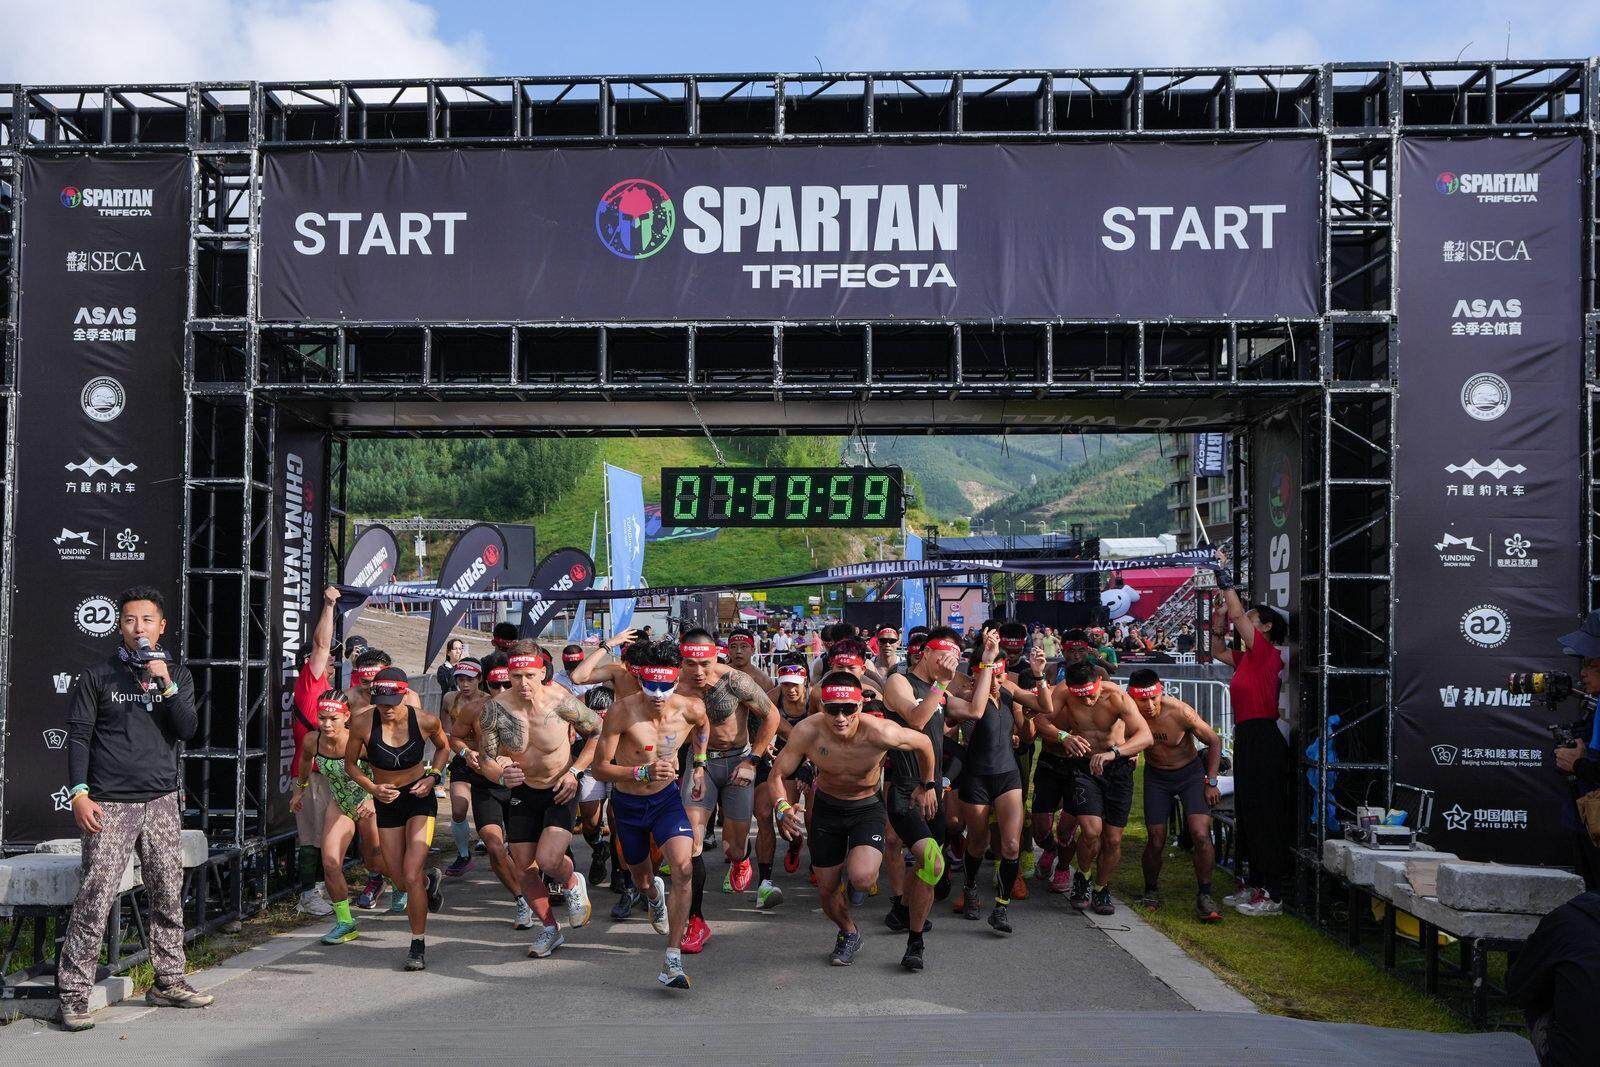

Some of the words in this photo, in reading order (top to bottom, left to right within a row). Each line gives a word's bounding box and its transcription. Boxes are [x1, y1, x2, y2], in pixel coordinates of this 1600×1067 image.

[1460, 173, 1539, 193] SPARTAN
[82, 188, 152, 207] SPARTAN
[98, 209, 152, 217] TRIFECTA
[682, 184, 958, 254] SPARTAN
[293, 211, 467, 257] START
[1102, 205, 1287, 250] START
[1469, 240, 1532, 261] SECA
[91, 251, 146, 272] SECA
[742, 263, 957, 289] TRIFECTA
[73, 328, 136, 341] 全季全体育
[1452, 322, 1522, 336] 全季全体育
[1206, 432, 1222, 471] RTAN
[284, 452, 304, 540] CHINA
[673, 475, 889, 520] 07:59:59
[1446, 484, 1525, 496] 方程豹汽车
[301, 511, 312, 611] SPARTAN
[96, 595, 118, 610] COMPANY
[1468, 605, 1482, 613] MILK
[1483, 604, 1508, 620] COMPANY
[83, 606, 111, 624] a2
[282, 546, 302, 686] NATIONAL
[1470, 616, 1501, 634] a2
[1461, 748, 1542, 760] 北京和睦家医院
[1474, 809, 1527, 822] 中国体育
